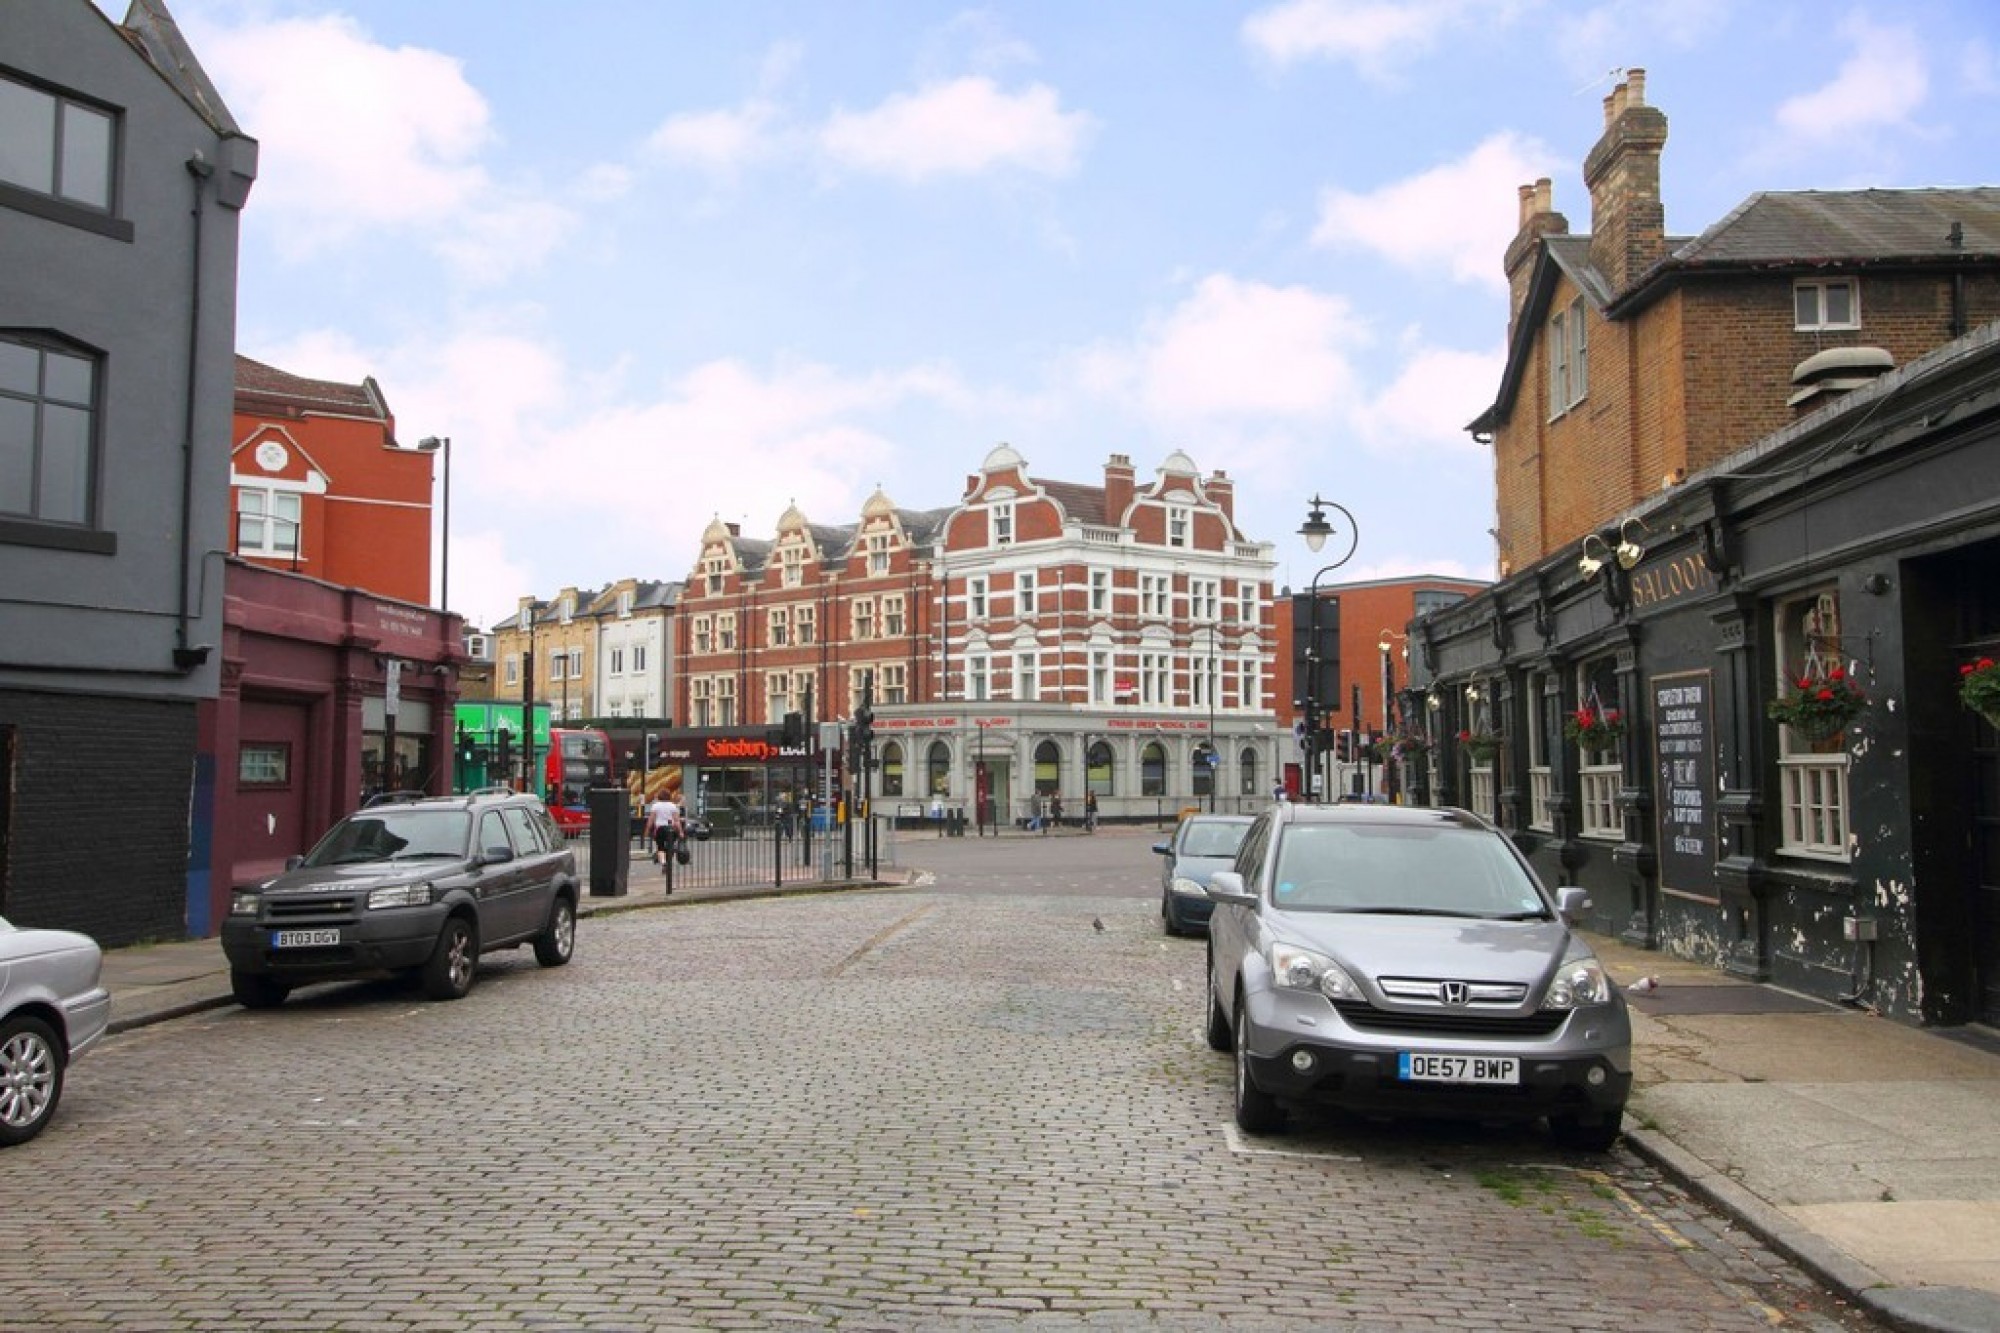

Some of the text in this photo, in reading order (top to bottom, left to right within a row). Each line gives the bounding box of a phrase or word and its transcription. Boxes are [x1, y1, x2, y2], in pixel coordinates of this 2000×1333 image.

[706, 738, 778, 760] Sainsburys
[1413, 1057, 1513, 1079] OE57 BWP
